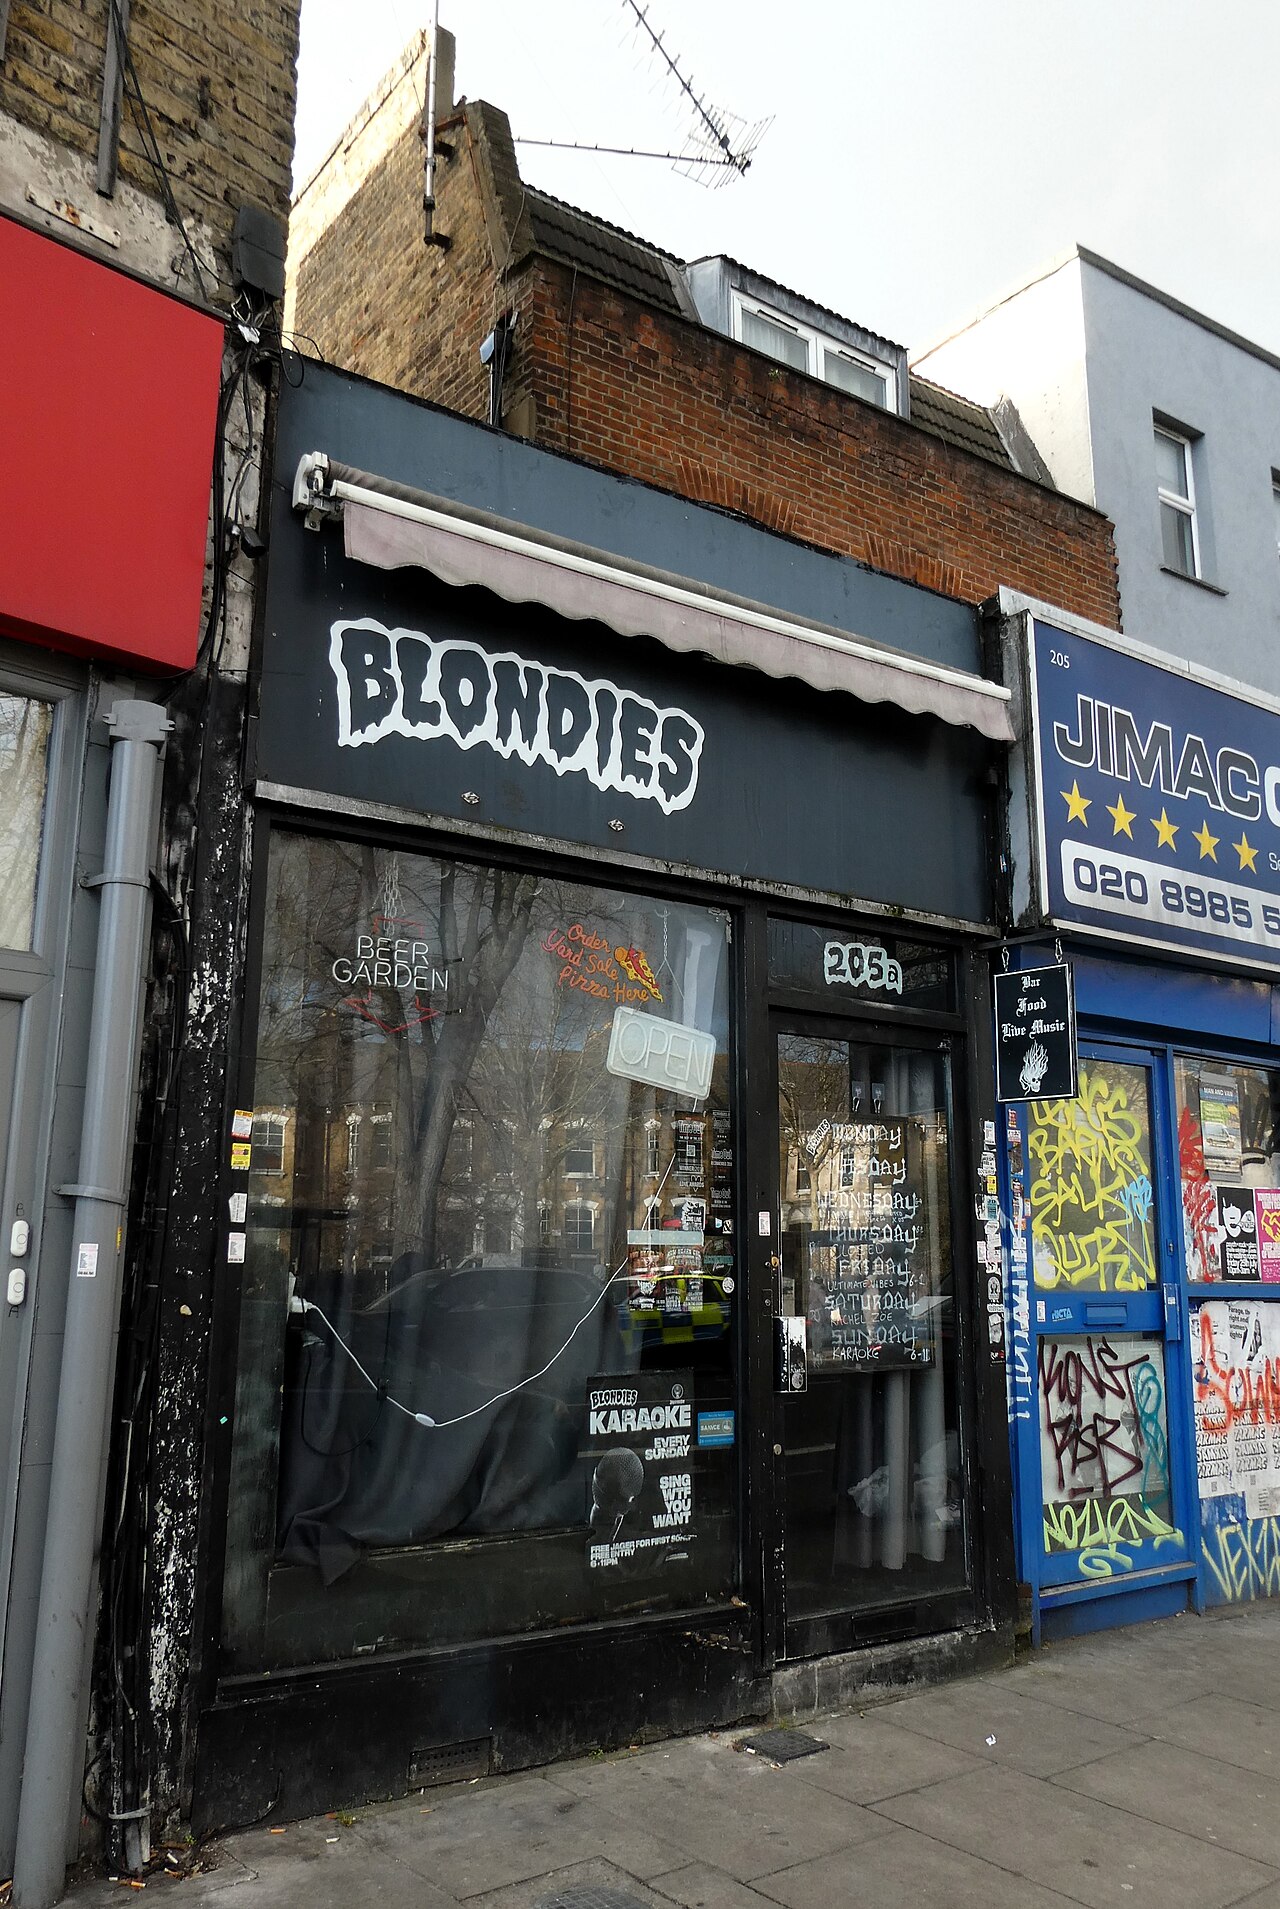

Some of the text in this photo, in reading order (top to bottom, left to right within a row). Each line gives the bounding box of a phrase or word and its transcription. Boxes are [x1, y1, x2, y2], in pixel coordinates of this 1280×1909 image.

[1050, 650, 1070, 669] 205
[329, 618, 706, 815] BLONDIES
[1073, 857, 1149, 905] 020
[1160, 879, 1253, 929] 8985
[568, 924, 611, 953] Order
[357, 936, 429, 965] BEER
[542, 928, 618, 980] Yard Sale
[332, 958, 449, 991] GARDEN
[824, 941, 903, 995] 205a
[558, 965, 649, 1003] Pizza Here
[1021, 975, 1041, 992] Bar
[1015, 996, 1047, 1017] Food
[1001, 1018, 1066, 1042] Live Music
[619, 1021, 709, 1086] OPEN
[824, 1291, 920, 1317] SATURDAY
[831, 1324, 918, 1354] SUNDAY
[832, 1345, 882, 1361] KARAOKE
[590, 1389, 638, 1410] BLONDIES
[590, 1404, 691, 1435] KARAOKE
[645, 1445, 690, 1461] SUNDAY
[654, 1435, 690, 1449] EVERY
[660, 1474, 691, 1489] SING
[661, 1486, 691, 1501] WTF
[664, 1498, 691, 1513] YOU
[652, 1511, 691, 1528] WANT
[590, 1545, 610, 1554] FREE
[636, 1538, 650, 1548] FOR
[590, 1548, 635, 1561] FREE ENTRY
